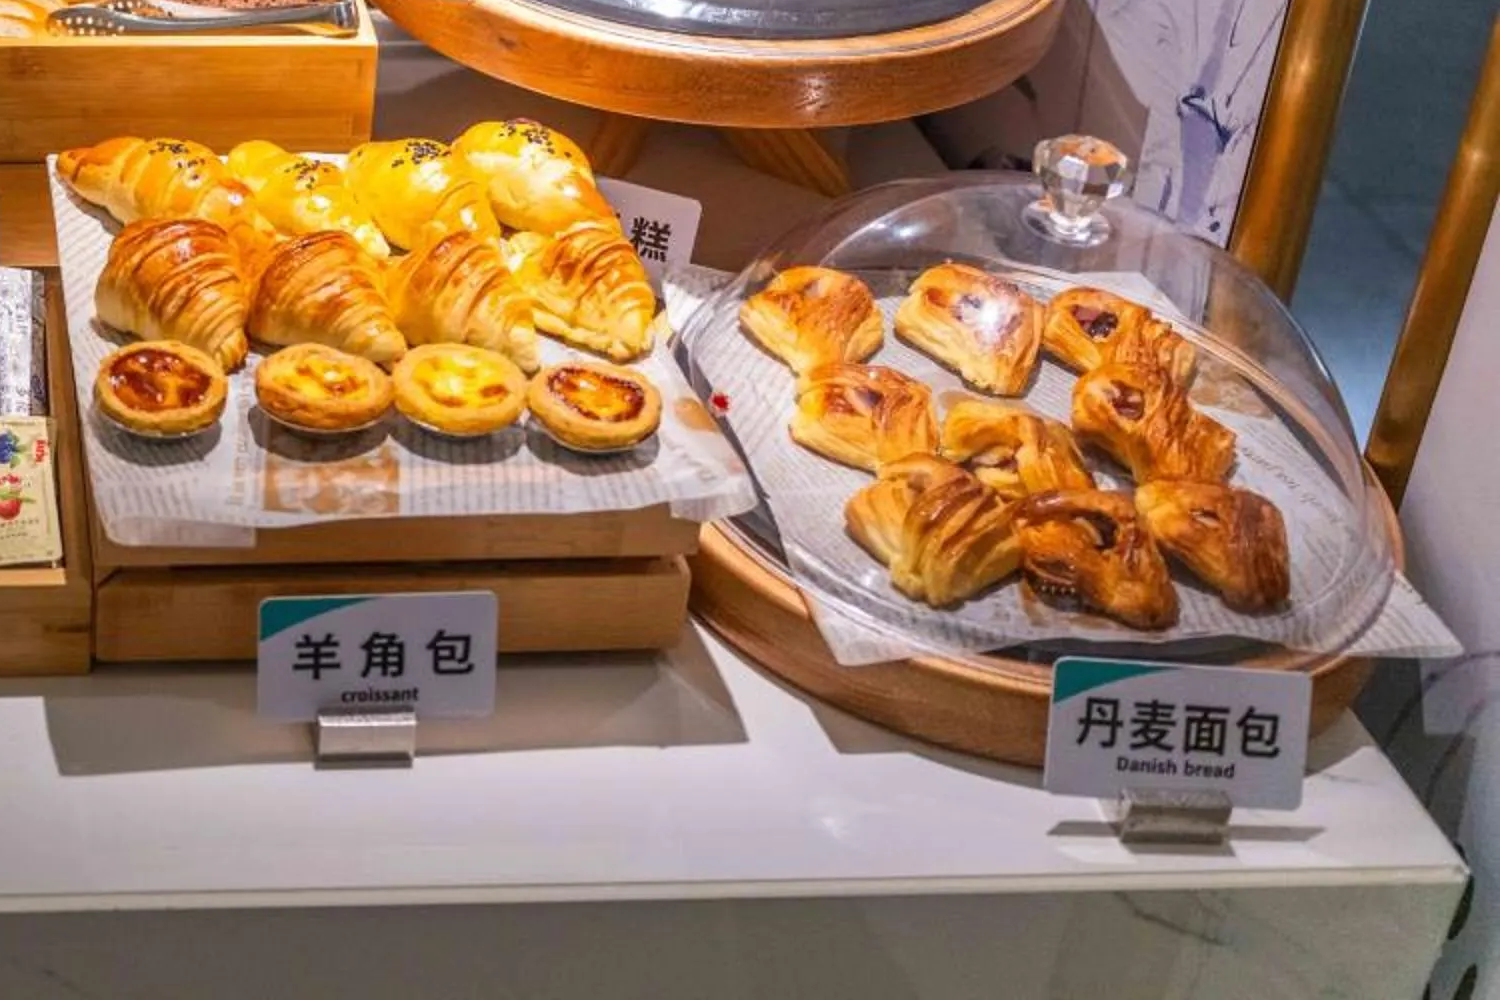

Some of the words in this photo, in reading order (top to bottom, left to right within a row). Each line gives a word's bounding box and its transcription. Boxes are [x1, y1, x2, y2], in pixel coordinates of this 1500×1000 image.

[615, 212, 671, 262] 糕
[292, 629, 476, 680] 羊角包
[341, 686, 420, 704] croissant
[1075, 695, 1281, 759] 丹麦面包
[1115, 756, 1178, 777] Danish
[1183, 761, 1236, 779] bread
